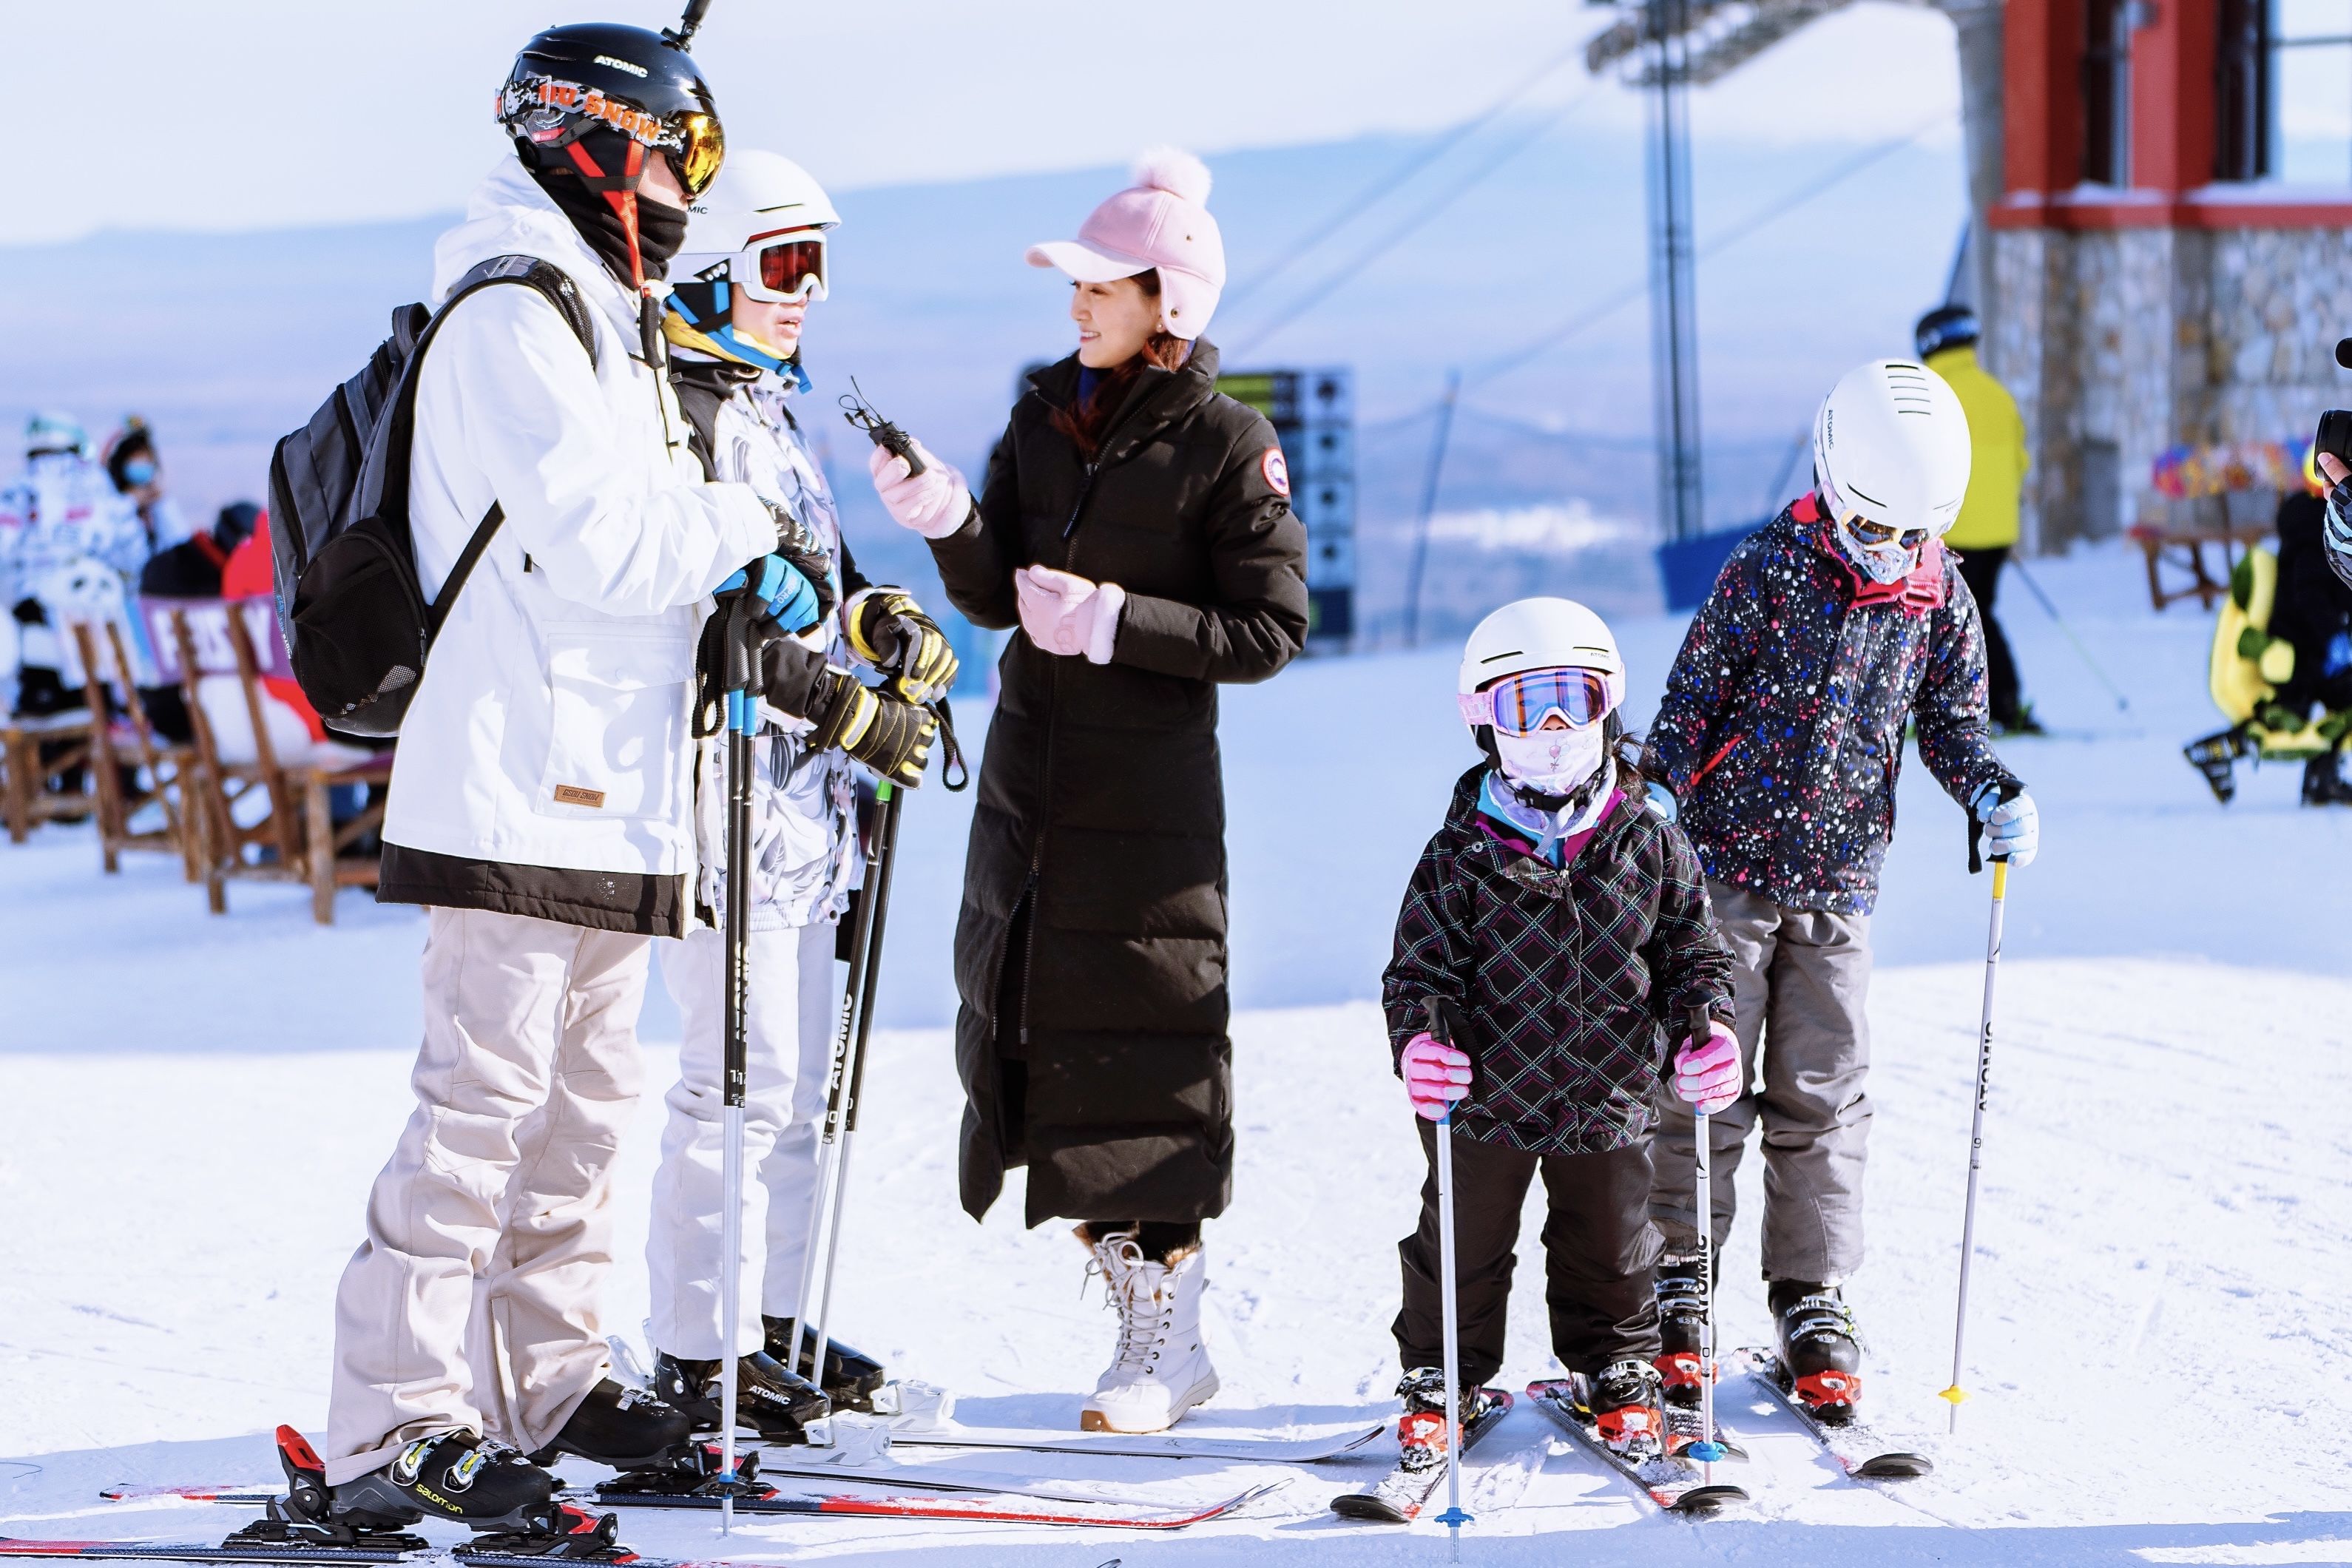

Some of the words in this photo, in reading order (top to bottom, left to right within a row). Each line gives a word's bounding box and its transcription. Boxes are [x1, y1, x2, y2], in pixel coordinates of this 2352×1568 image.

[593, 55, 649, 78] ATOMIC
[584, 93, 662, 141] SNOW
[748, 1385, 791, 1405] ATOMIC
